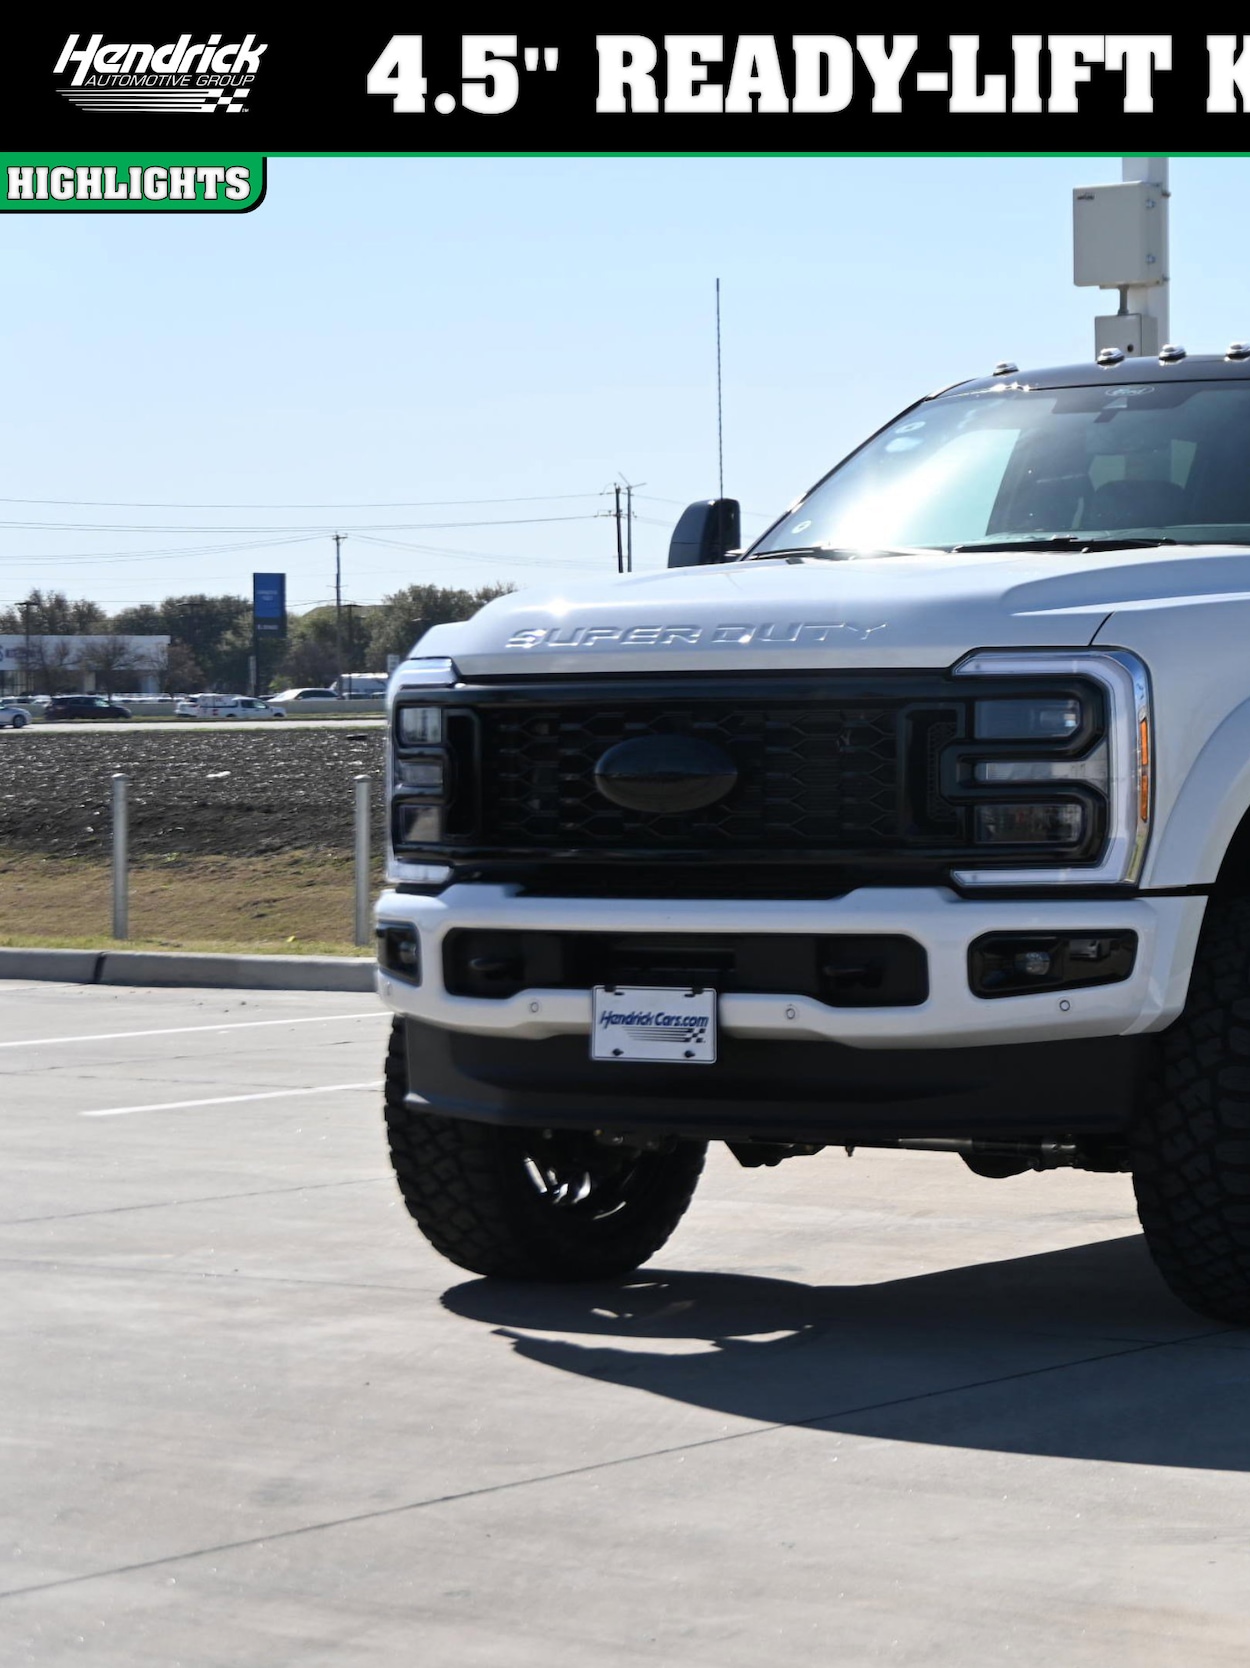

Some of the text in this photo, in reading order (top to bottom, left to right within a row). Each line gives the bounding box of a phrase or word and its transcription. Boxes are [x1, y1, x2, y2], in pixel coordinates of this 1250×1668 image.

[505, 621, 889, 649] SUPER DUTY
[599, 1010, 710, 1030] HendrickCars.com
